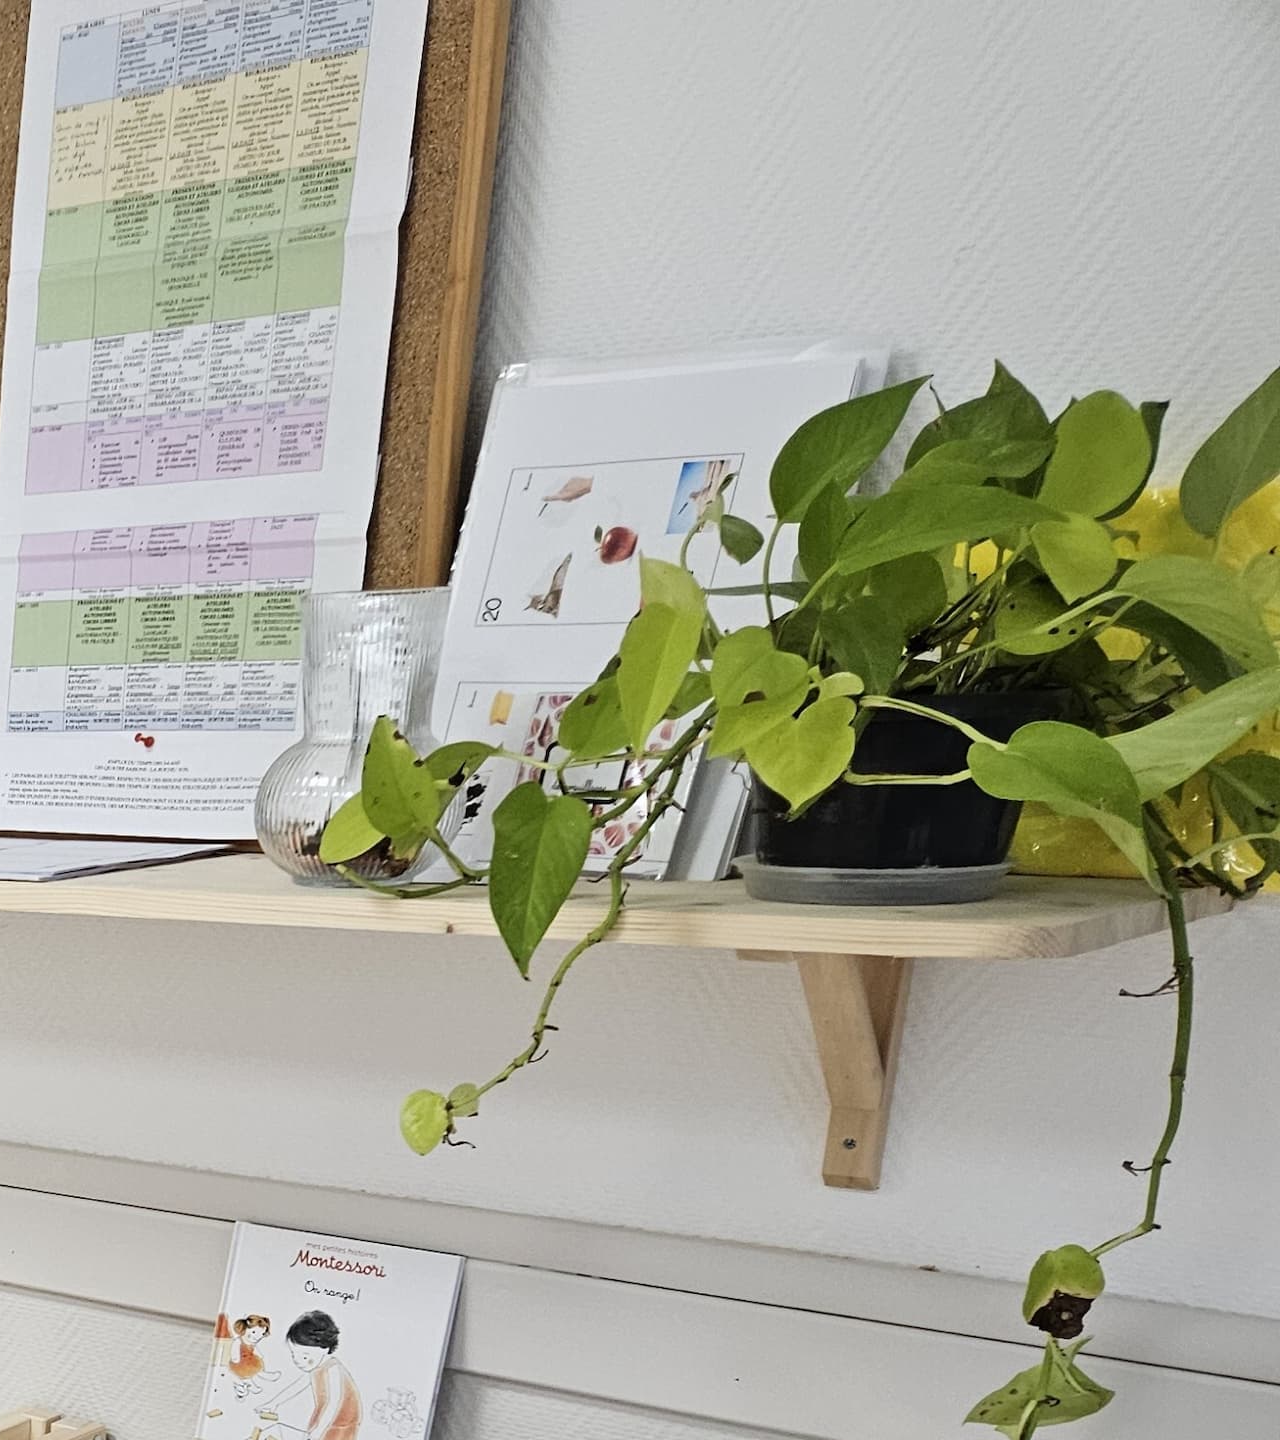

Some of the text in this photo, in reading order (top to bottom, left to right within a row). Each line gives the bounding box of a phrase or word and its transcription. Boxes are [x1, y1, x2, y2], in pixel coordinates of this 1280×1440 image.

[482, 597, 502, 622] 20
[290, 1249, 387, 1278] Montessori
[304, 1280, 321, 1294] On
